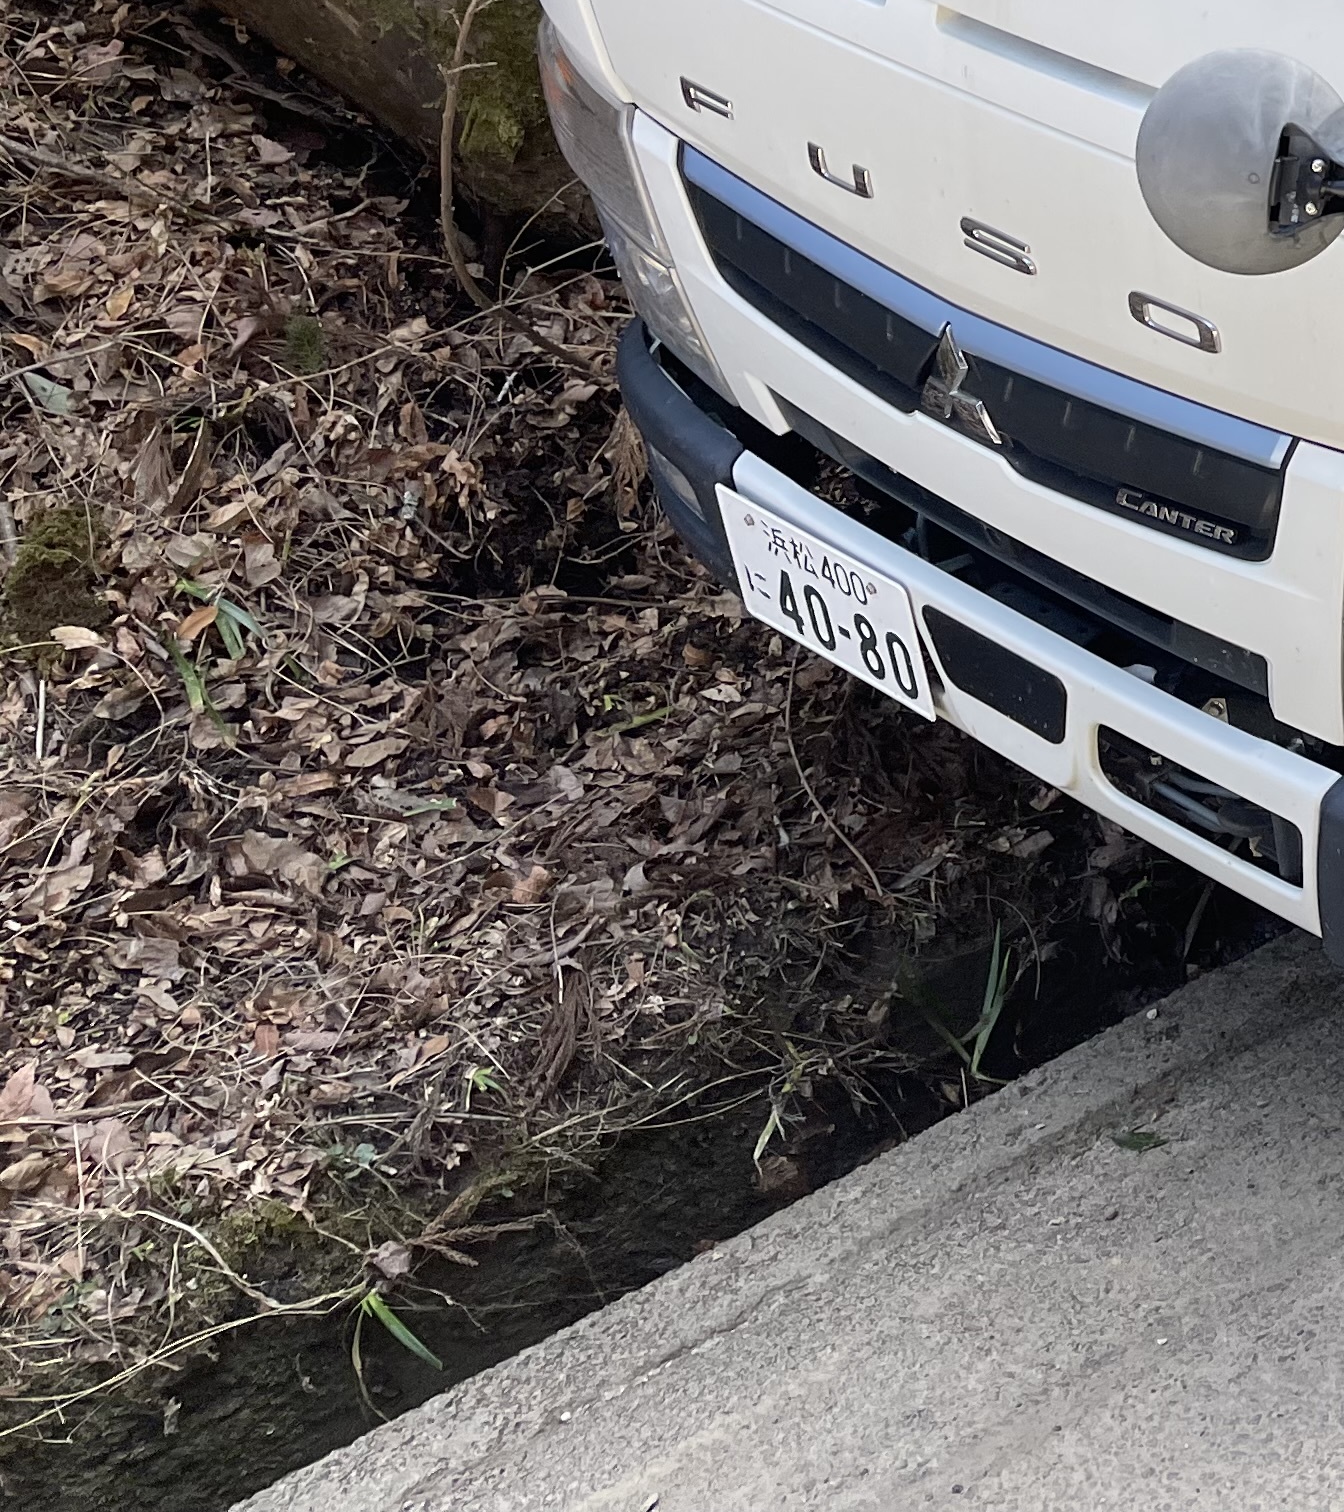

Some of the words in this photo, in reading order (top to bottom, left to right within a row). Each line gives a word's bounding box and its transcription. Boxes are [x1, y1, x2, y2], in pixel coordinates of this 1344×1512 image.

[679, 75, 1222, 354] FUSO
[1115, 487, 1235, 545] CANTER
[744, 564, 771, 600] に
[779, 569, 919, 700] 40-80
